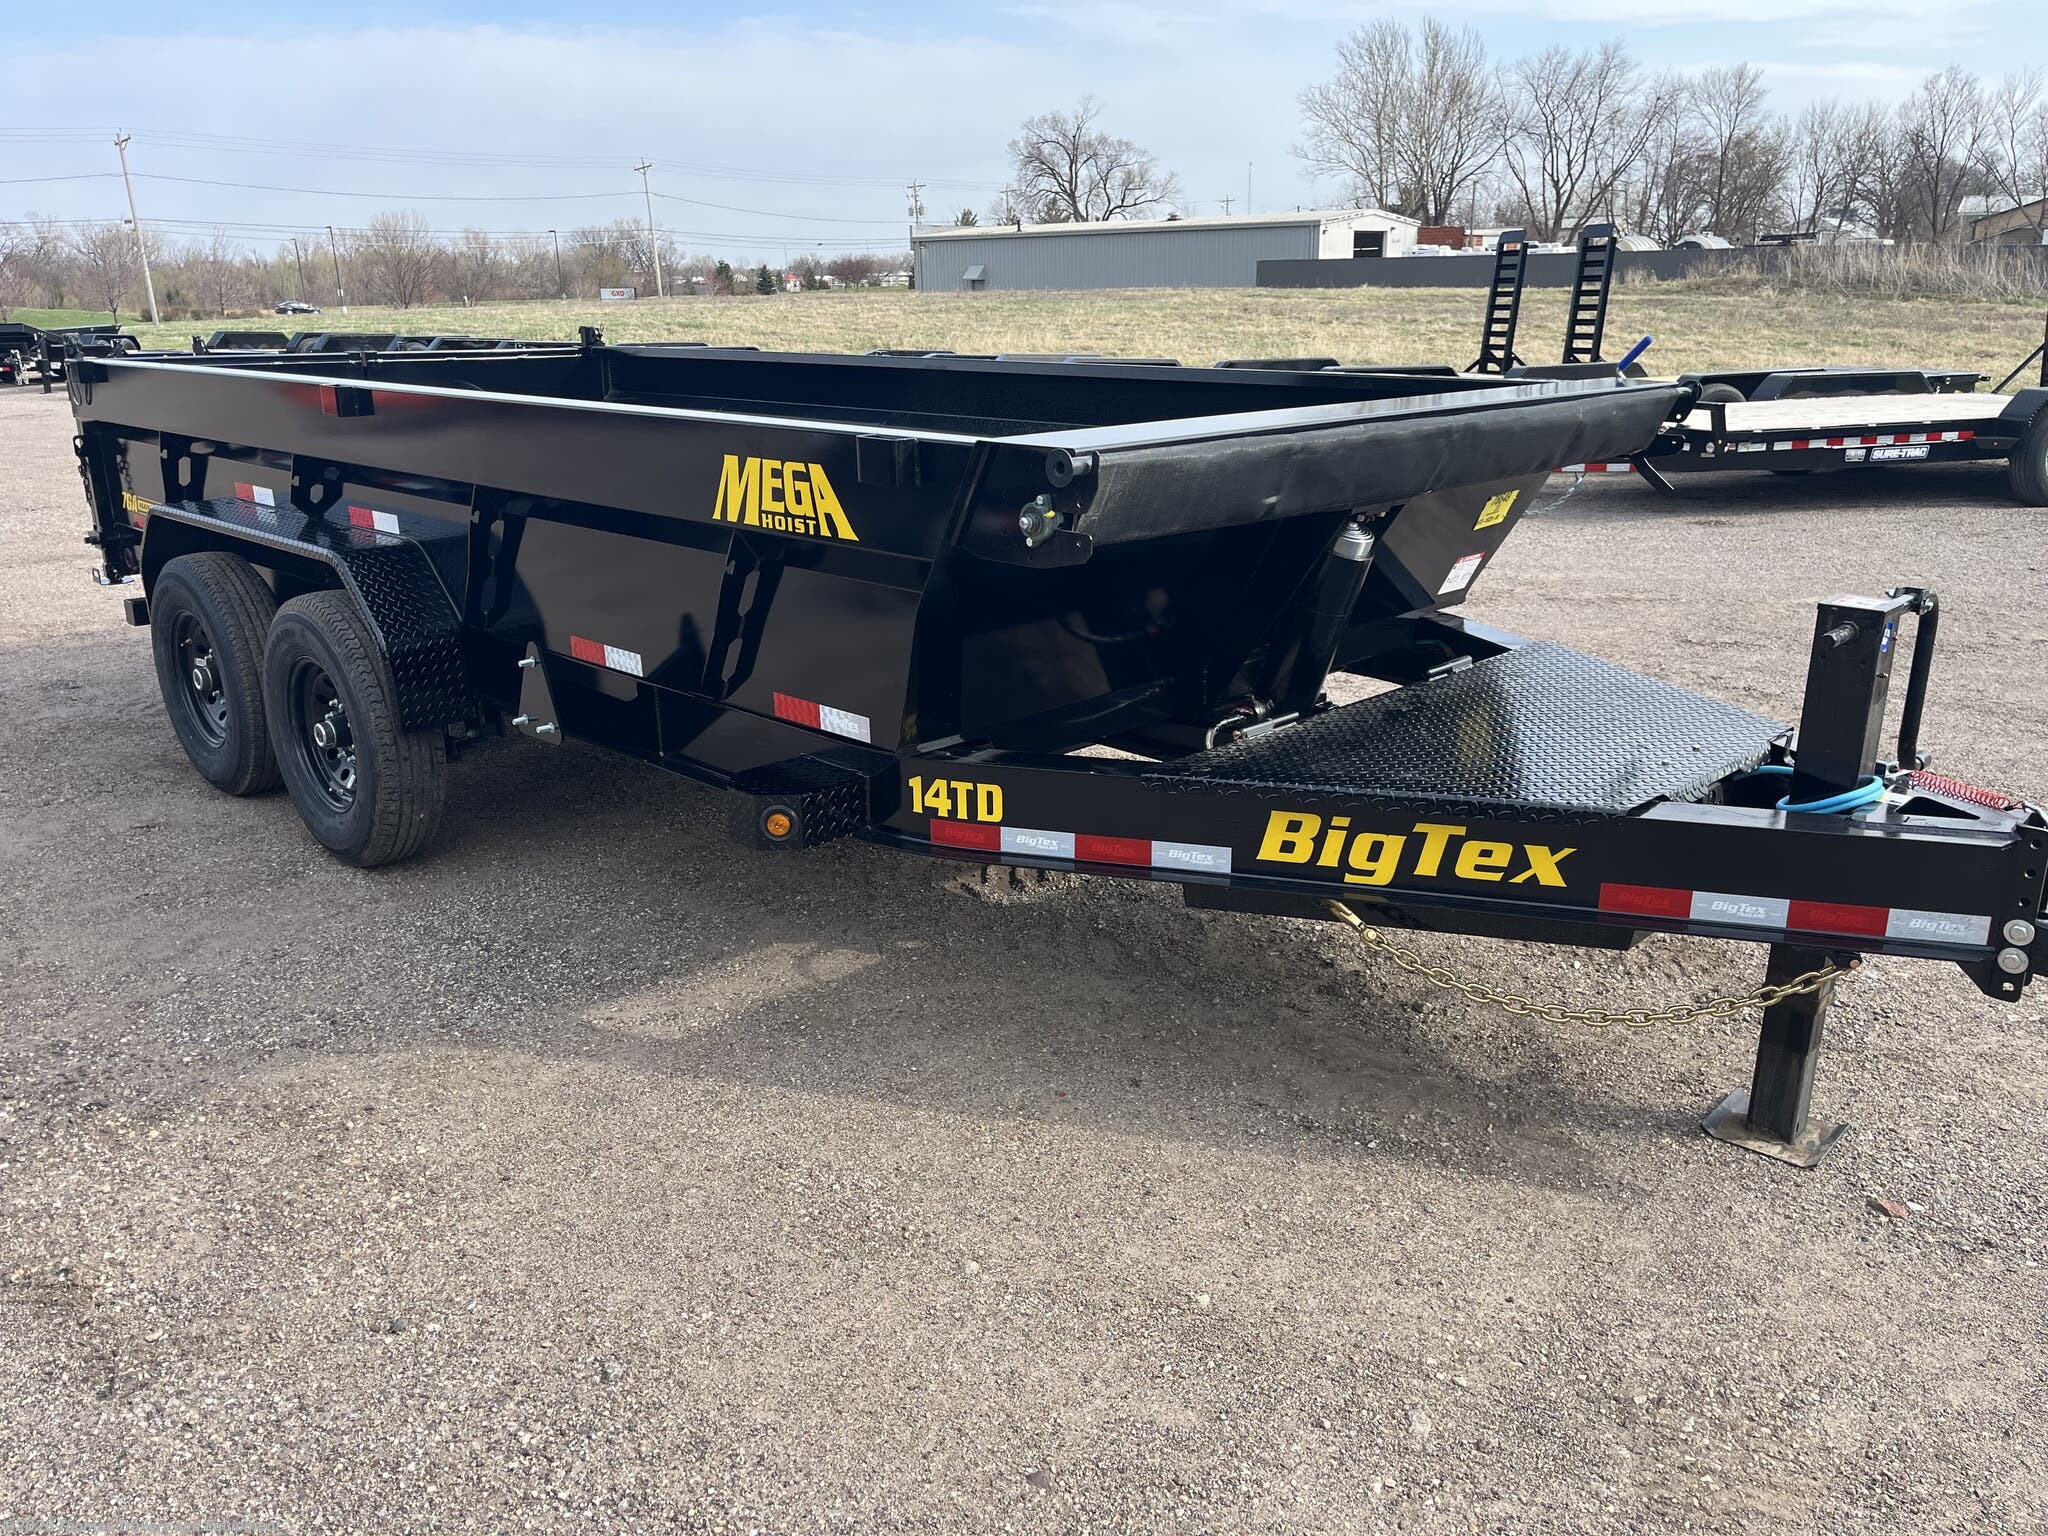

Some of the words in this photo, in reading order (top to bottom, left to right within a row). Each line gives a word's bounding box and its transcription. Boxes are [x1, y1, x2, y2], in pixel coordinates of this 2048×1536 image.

[1872, 447, 1927, 459] SURE-TRAC
[712, 454, 860, 541] MEGA
[761, 513, 816, 535] HOIST
[908, 775, 1004, 823] 14TD
[1015, 834, 1059, 848] BigTex
[1256, 810, 1578, 887] BigTex
[1168, 849, 1214, 862] BigTex
[1711, 900, 1767, 915] BigTex
[1909, 918, 1969, 932] BigTex
